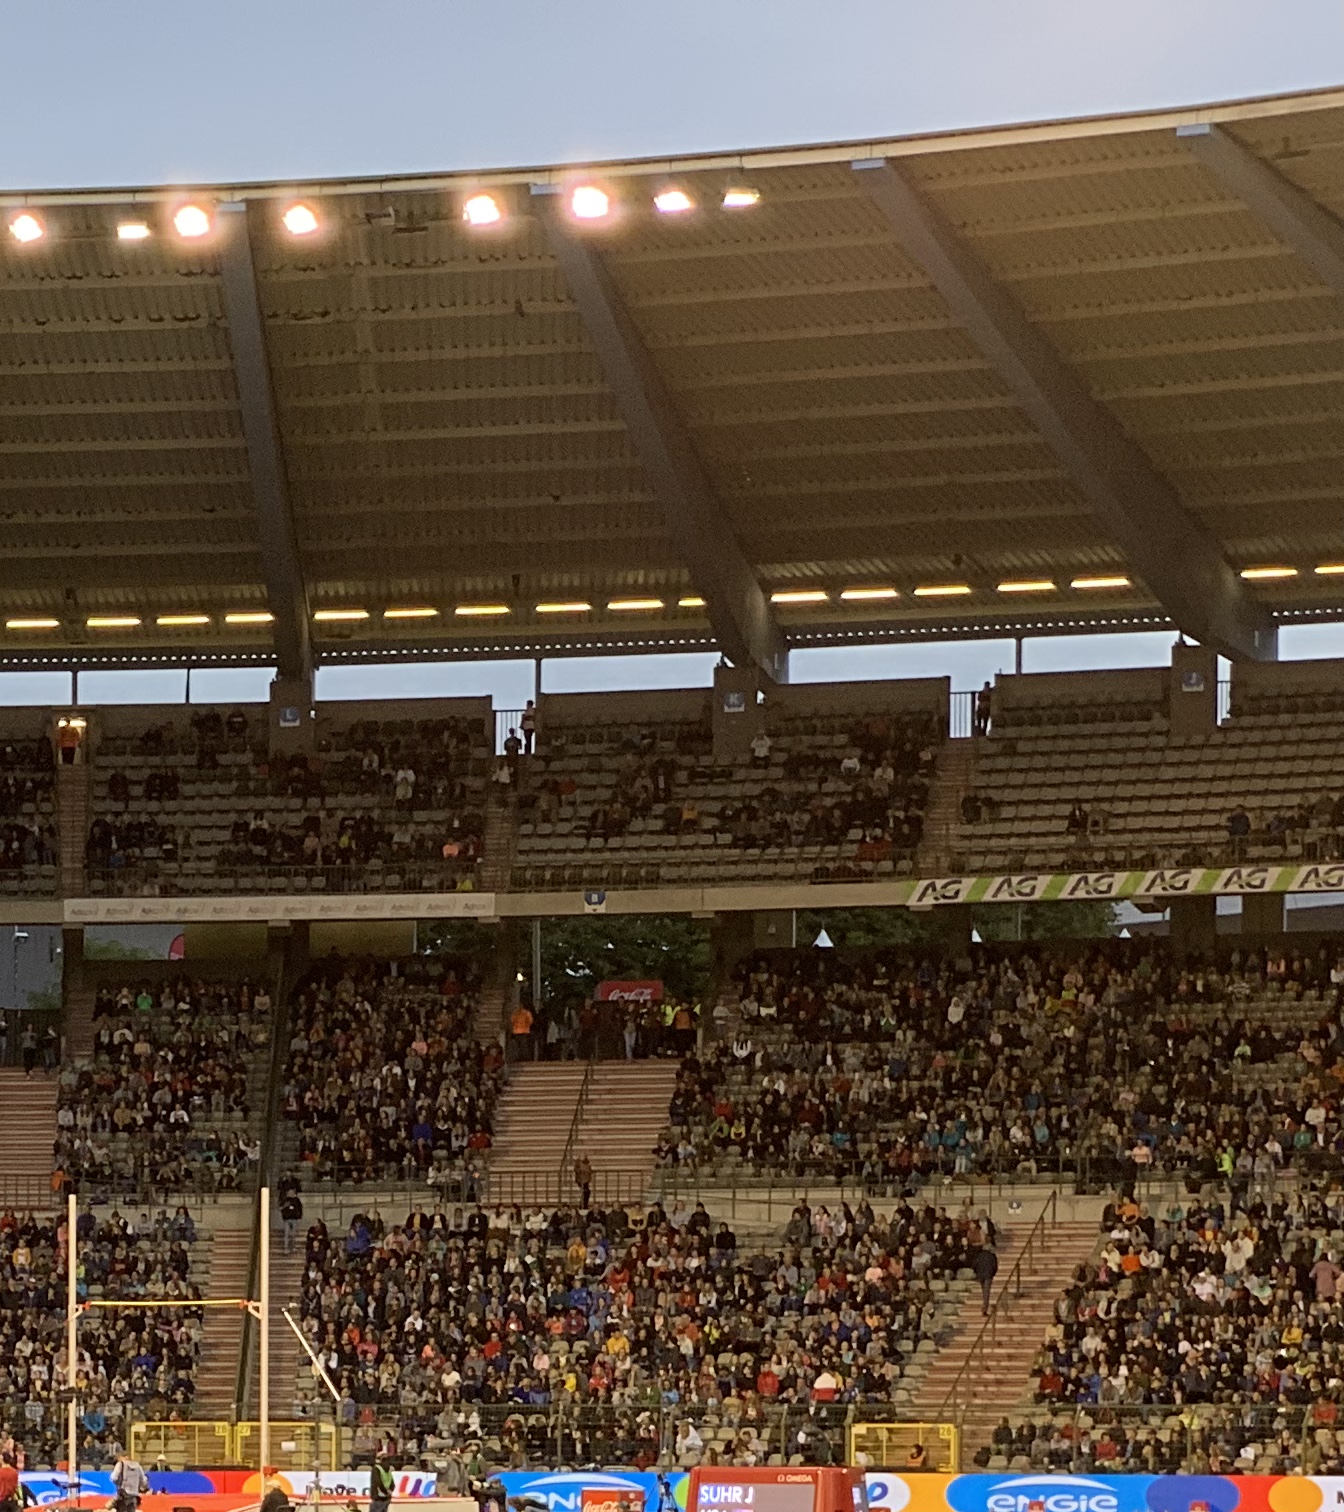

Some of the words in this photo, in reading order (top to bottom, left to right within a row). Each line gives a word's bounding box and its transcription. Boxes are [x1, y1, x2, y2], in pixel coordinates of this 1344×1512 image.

[916, 879, 962, 902] AG
[991, 876, 1038, 898] AG
[1068, 874, 1115, 895] AG
[1144, 869, 1192, 892] AG
[1221, 867, 1268, 889] AG
[700, 1486, 742, 1503] SUHR
[745, 1486, 754, 1503] J
